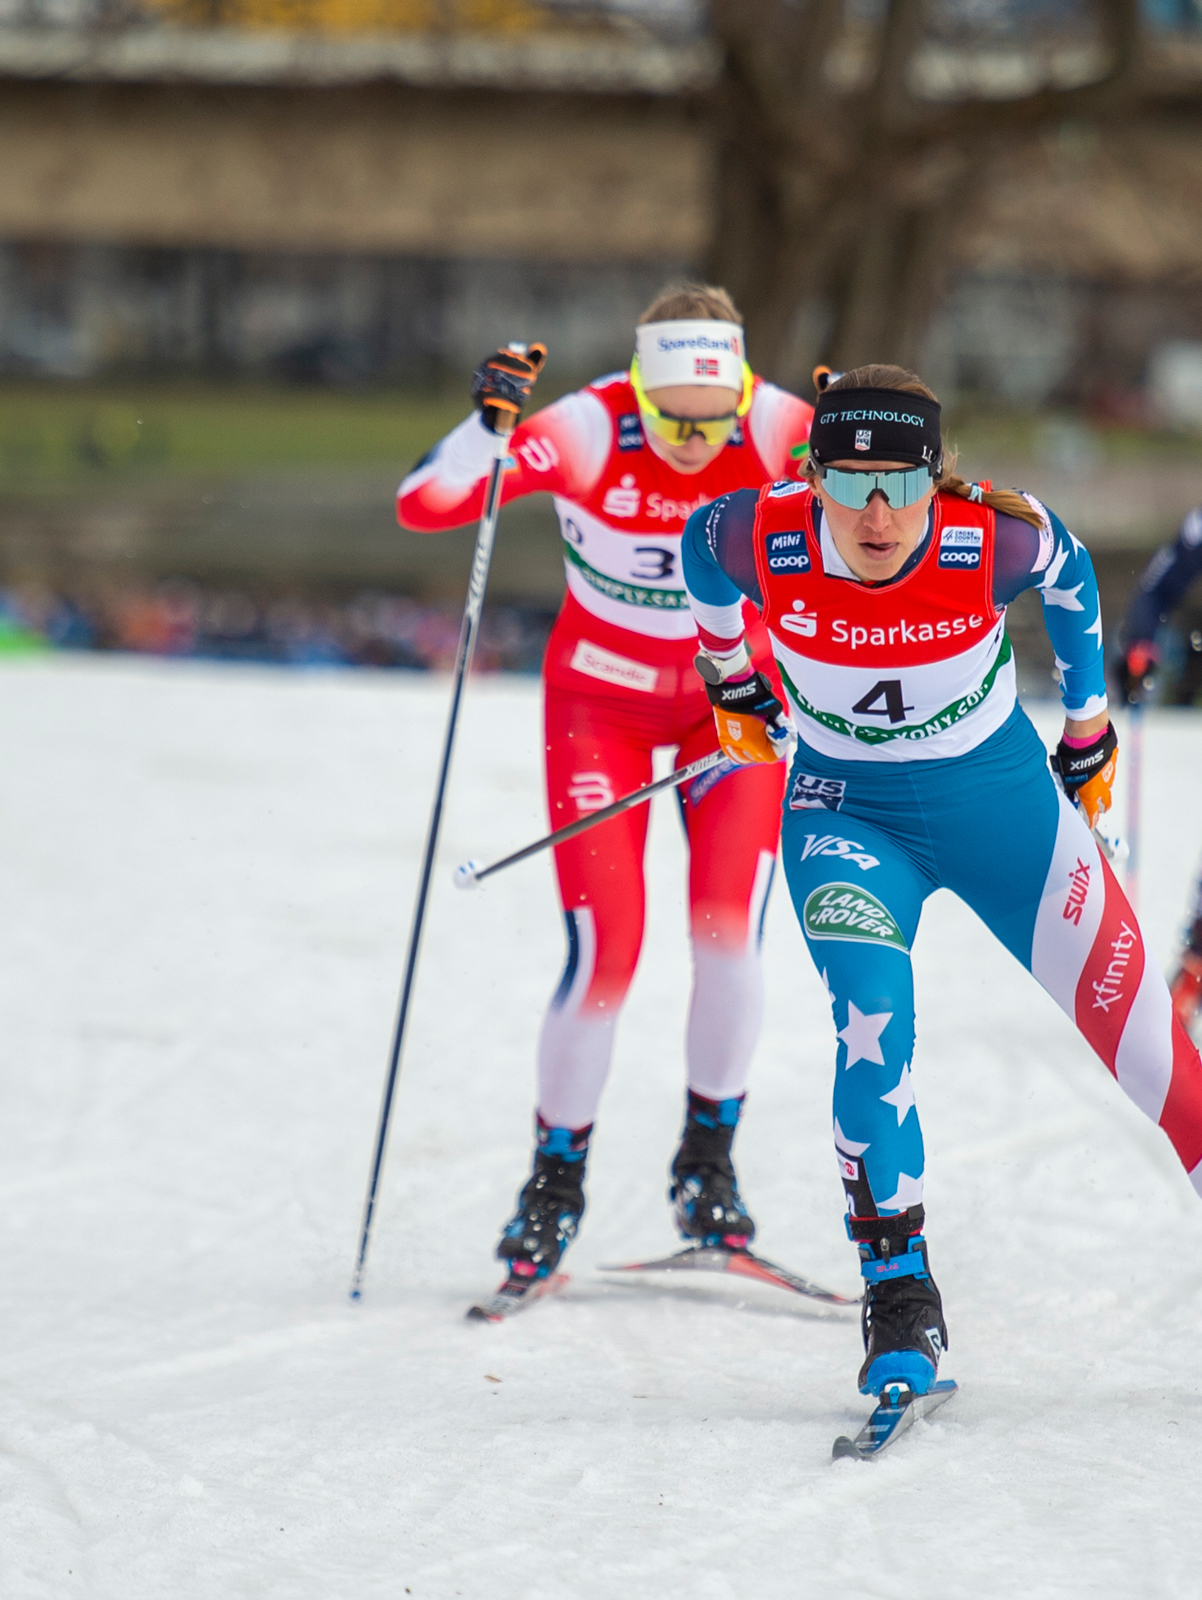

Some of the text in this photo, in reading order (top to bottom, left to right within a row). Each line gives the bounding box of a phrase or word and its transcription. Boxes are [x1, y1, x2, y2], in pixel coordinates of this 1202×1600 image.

[820, 410, 925, 428] GTY TECHNOLOGY
[630, 547, 675, 580] 3
[769, 555, 809, 568] coop
[940, 551, 980, 565] coop
[831, 614, 984, 650] Sparkasse
[851, 679, 915, 724] 4
[796, 775, 843, 796] US
[800, 834, 881, 871] VISA
[818, 890, 887, 918] LAND
[814, 908, 894, 938] ROVER
[1092, 920, 1137, 1013] xfinity
